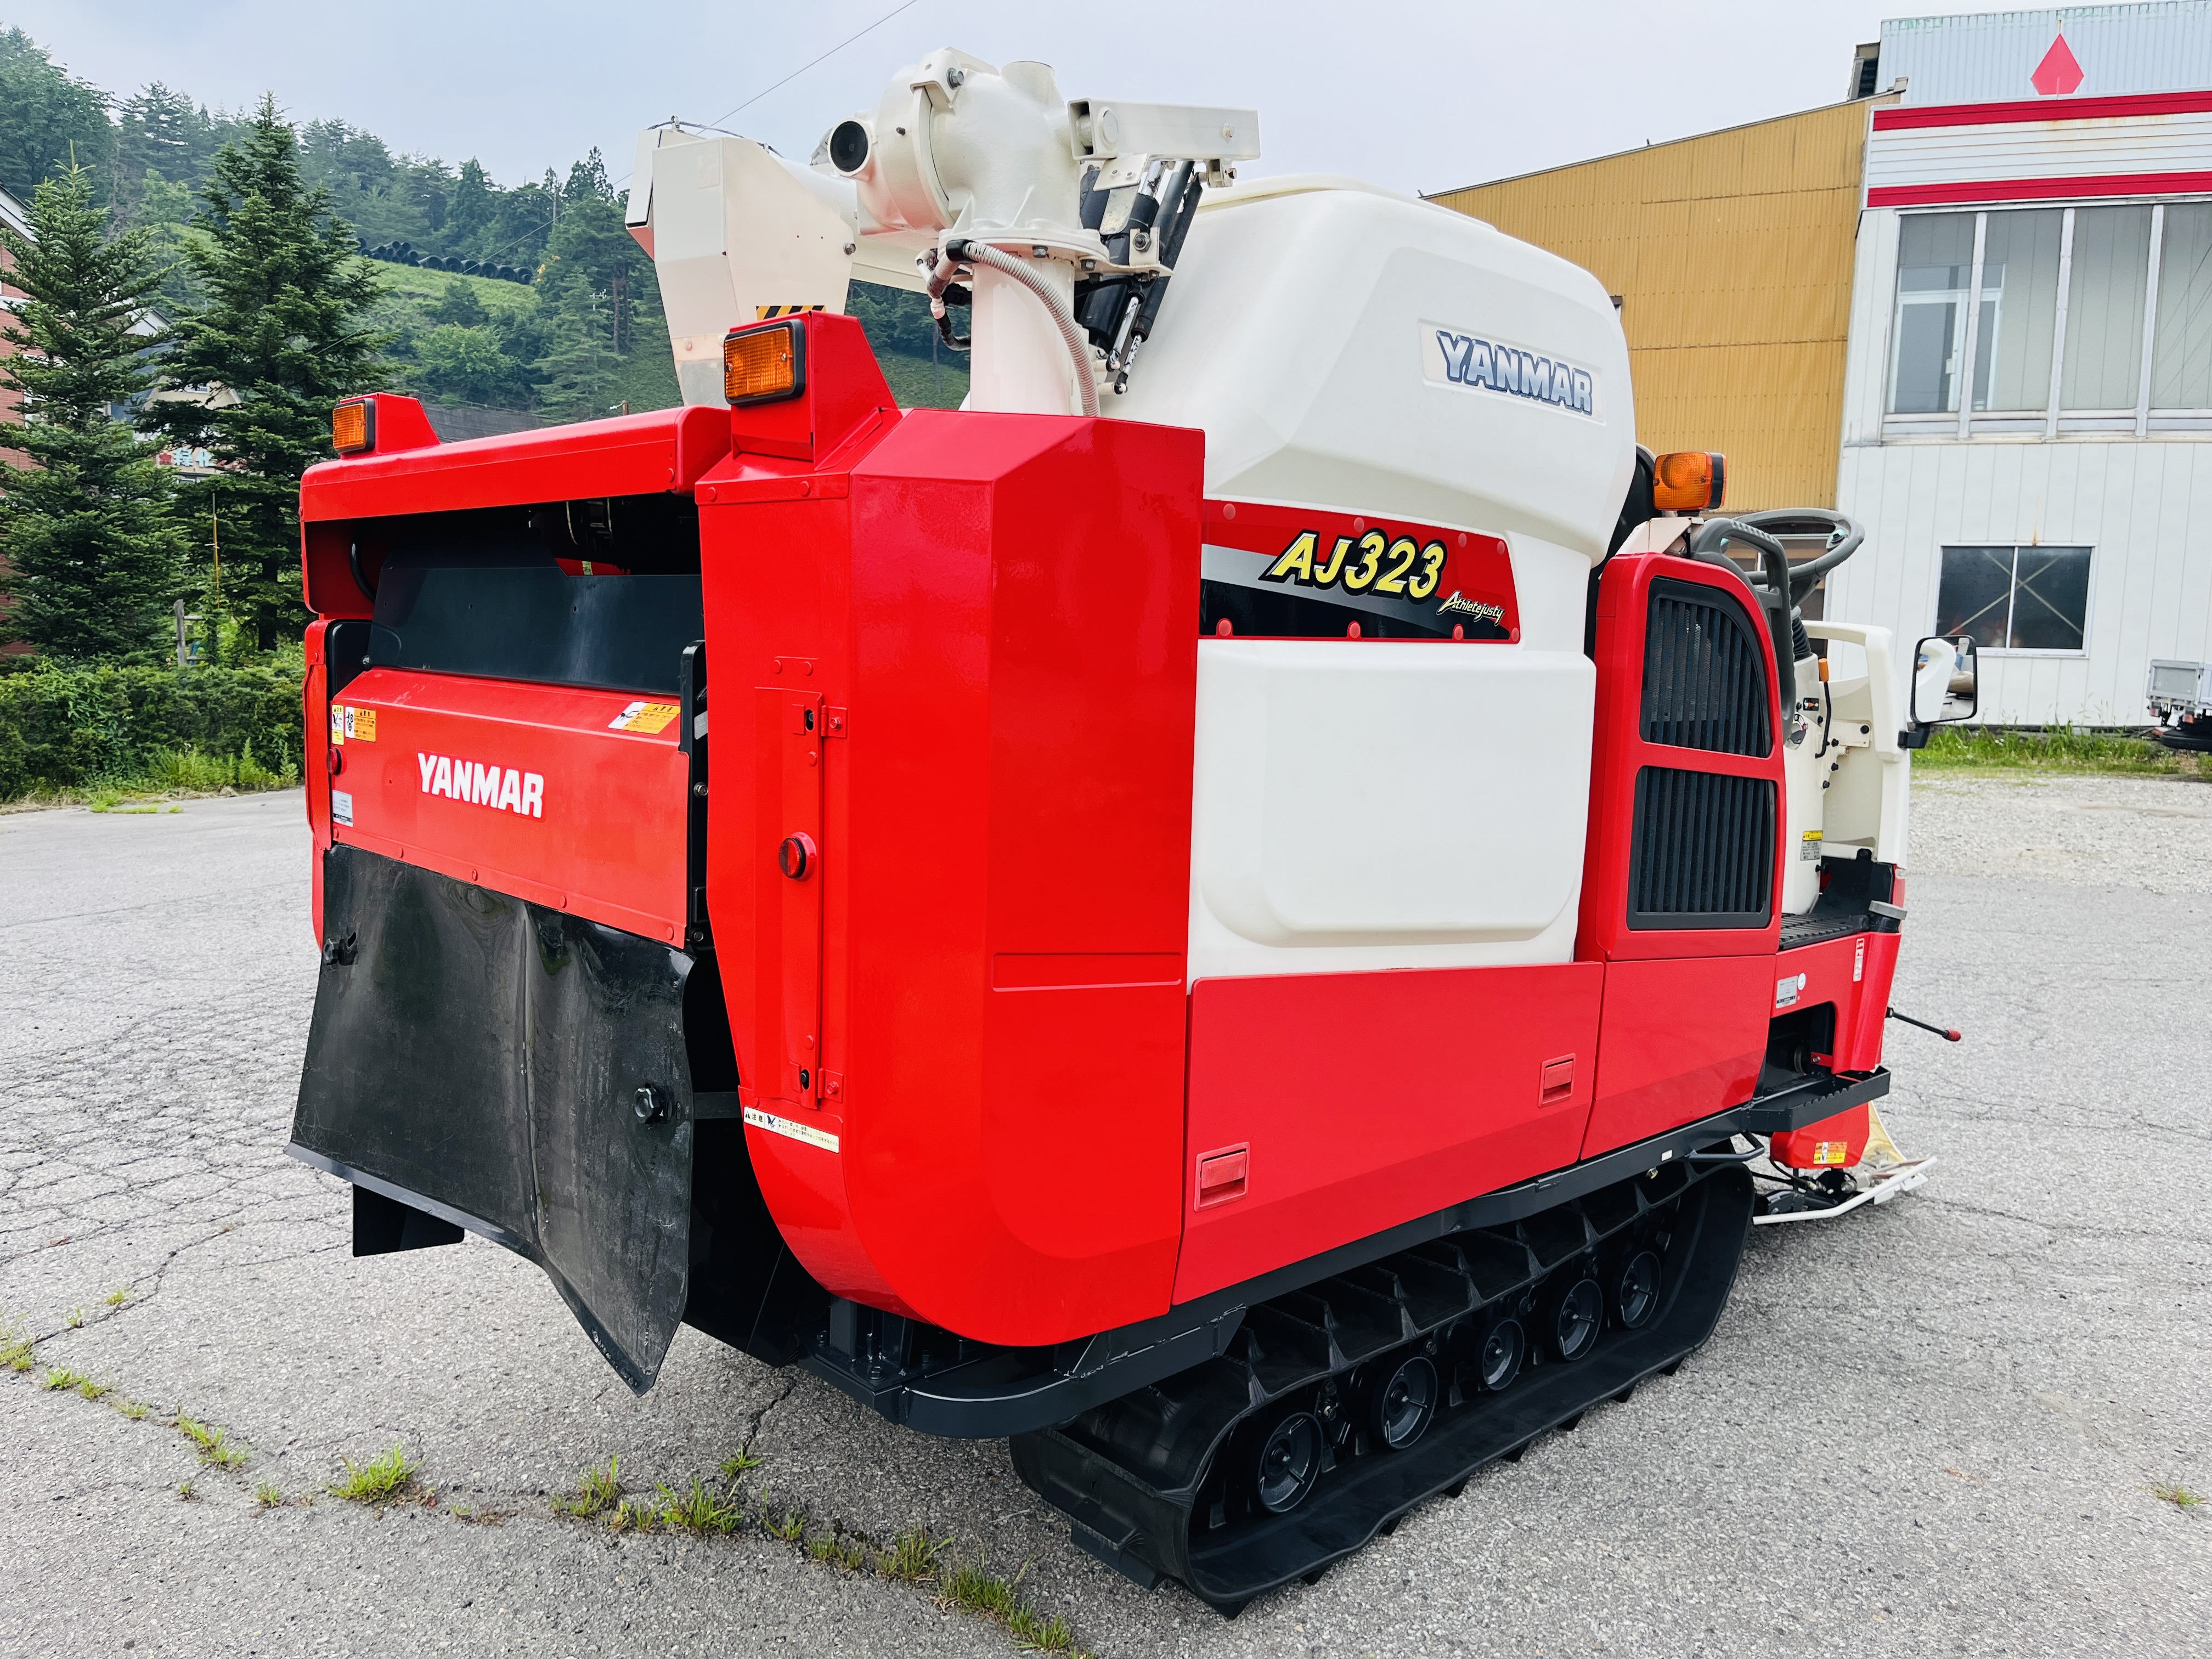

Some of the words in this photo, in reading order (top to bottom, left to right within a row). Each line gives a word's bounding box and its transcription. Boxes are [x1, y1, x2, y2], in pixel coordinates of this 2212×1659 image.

[1436, 330, 1592, 416] YANMAR
[1261, 529, 1446, 601] AJ323
[1437, 591, 1505, 626] Athletejusty
[417, 752, 544, 819] YANMAR
